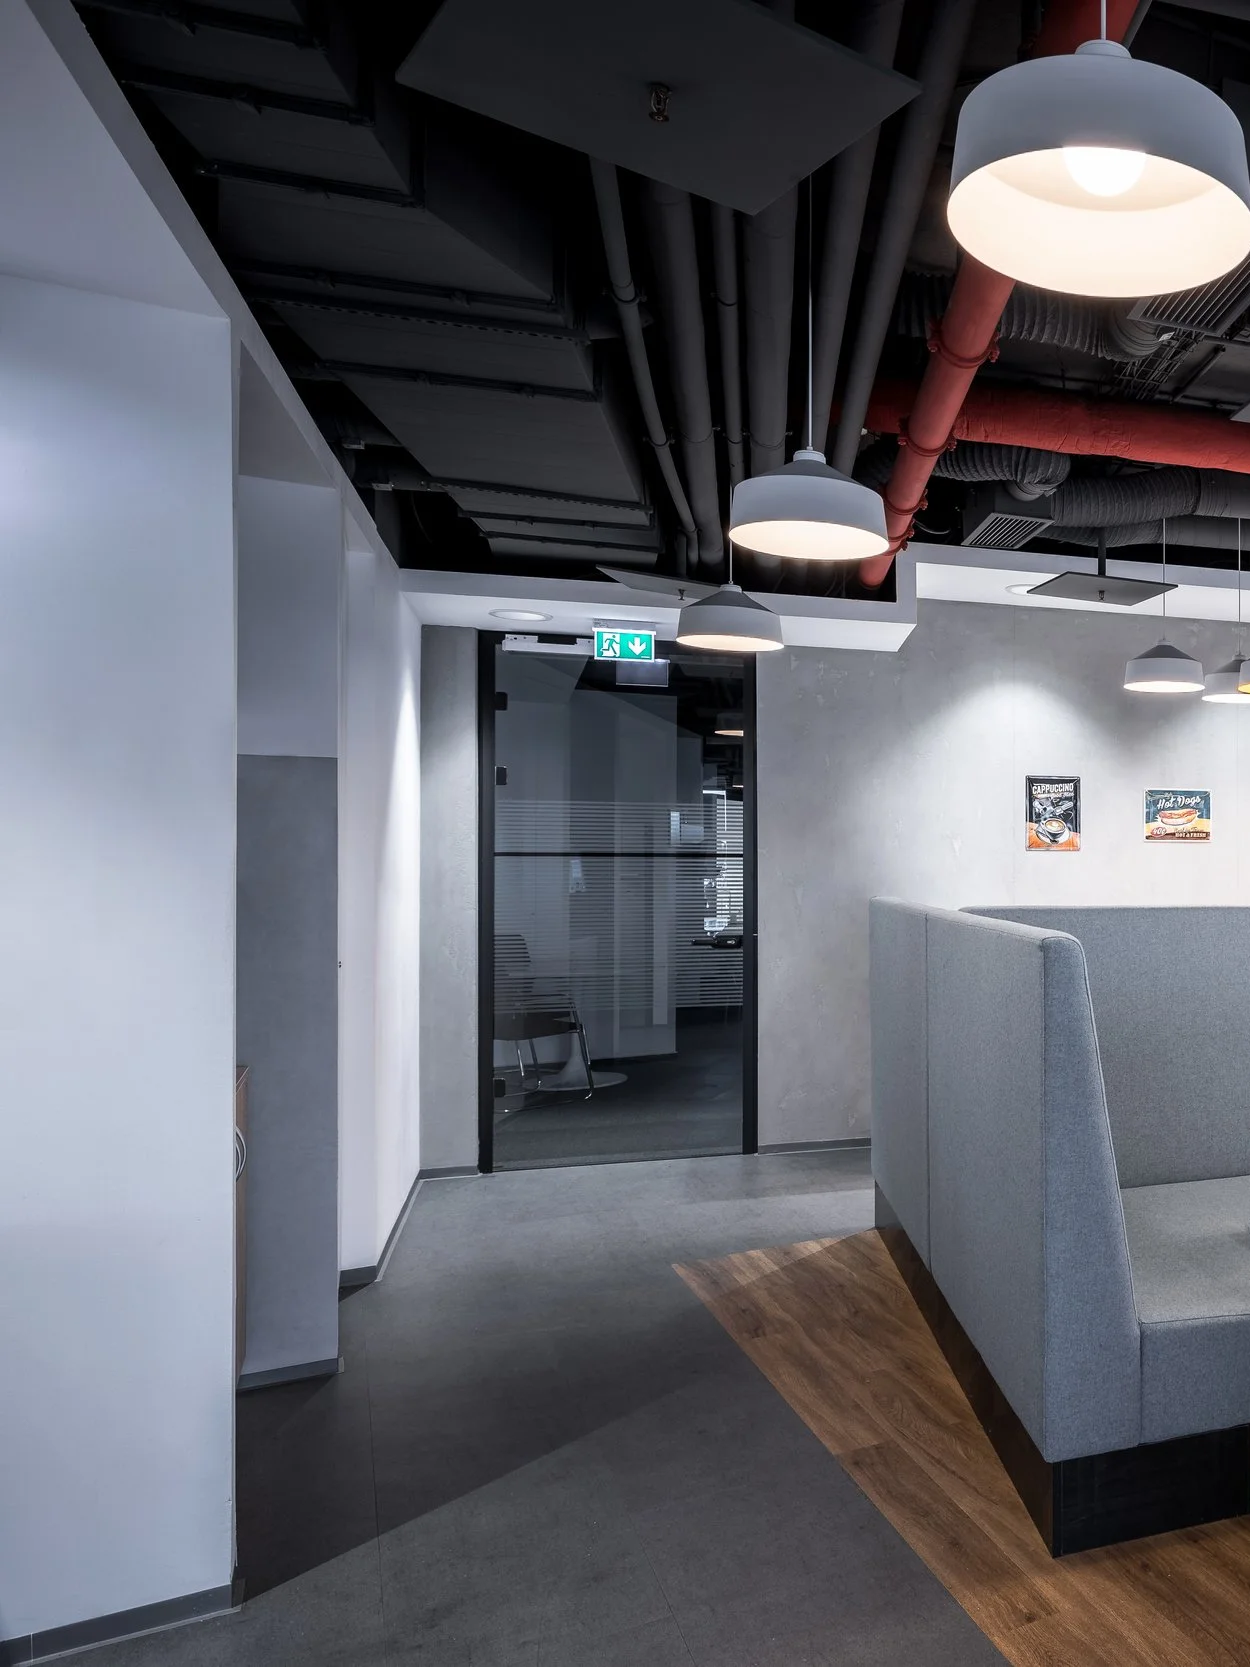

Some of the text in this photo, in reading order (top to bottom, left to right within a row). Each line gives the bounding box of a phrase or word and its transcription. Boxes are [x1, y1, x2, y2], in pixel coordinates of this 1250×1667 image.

[1032, 783, 1074, 794] CAPPUCCINO
[1157, 797, 1176, 810] Hot
[1177, 795, 1201, 807] Dogs
